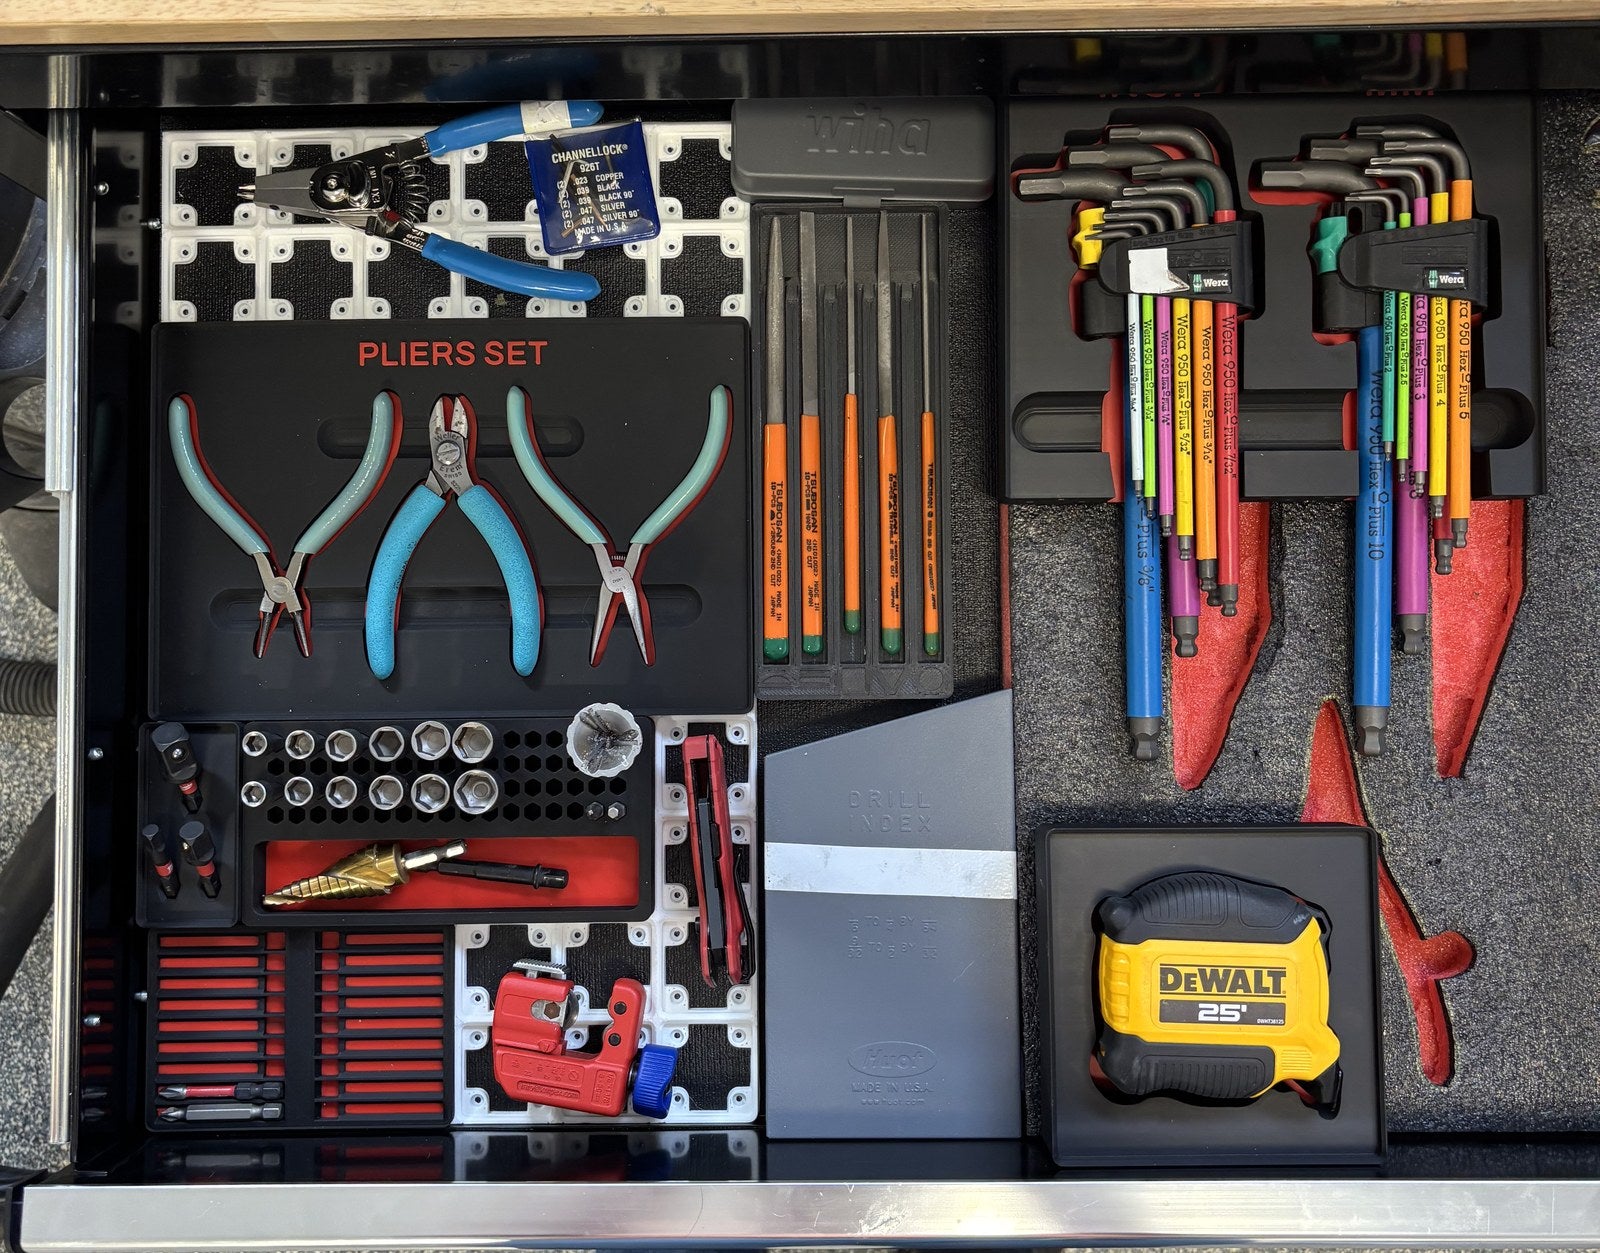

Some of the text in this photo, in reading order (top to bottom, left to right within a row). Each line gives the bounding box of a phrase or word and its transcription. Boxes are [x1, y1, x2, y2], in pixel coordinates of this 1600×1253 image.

[580, 162, 600, 173] 926T
[595, 172, 624, 182] COPPER
[575, 187, 590, 196] .039
[597, 182, 620, 192] BLACK
[560, 200, 570, 209] (2)
[577, 197, 591, 206] .039
[599, 191, 622, 201] BLACK
[562, 202, 625, 218] (2) .047 SILVER
[564, 219, 574, 229] (2)
[602, 212, 626, 222] SILVER
[575, 224, 595, 236] MADE
[597, 224, 605, 233] IN
[1203, 278, 1229, 287] Wera
[1439, 275, 1464, 284] Wera
[1384, 290, 1392, 314] Wera
[1416, 295, 1426, 310] ra
[1435, 297, 1445, 316] era
[1459, 300, 1469, 318] ra
[1144, 319, 1152, 345] Wera
[1384, 316, 1392, 330] 950
[1400, 323, 1408, 337] 950
[1416, 313, 1426, 333] 950
[1436, 319, 1446, 339] 950
[1177, 314, 1190, 351] Wera
[1222, 315, 1235, 356] Wera
[1459, 322, 1469, 345] 950
[1161, 330, 1169, 355] Wera
[1202, 326, 1211, 360] Wera
[359, 340, 548, 367] PLIERS SET
[1161, 358, 1169, 374] 950
[1178, 354, 1189, 377] 950
[1203, 363, 1212, 386] 950
[1223, 360, 1236, 388] 950
[1400, 373, 1408, 385] 2.5
[1436, 399, 1446, 407] 4
[1459, 411, 1469, 419] 5
[1369, 542, 1384, 560] 10
[848, 789, 930, 808] DRILL
[848, 814, 930, 832] INDEX
[851, 1081, 881, 1092] MADE
